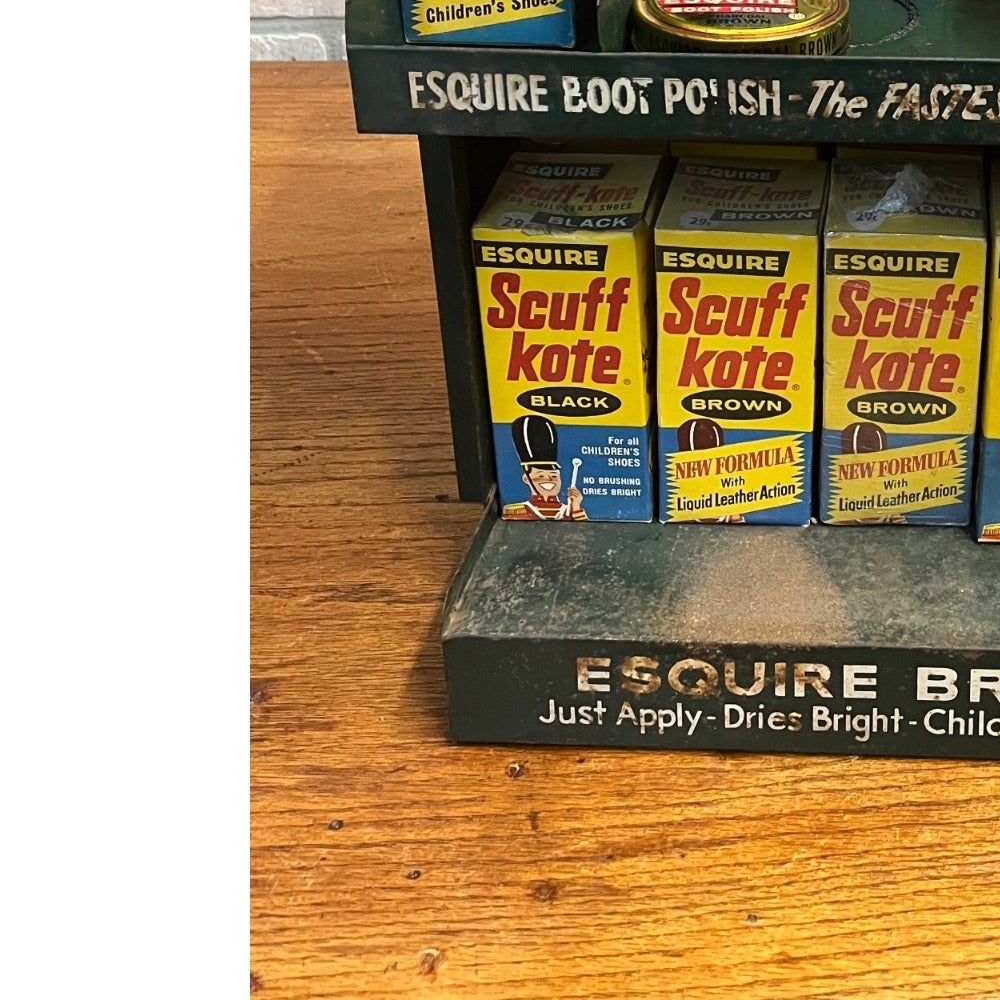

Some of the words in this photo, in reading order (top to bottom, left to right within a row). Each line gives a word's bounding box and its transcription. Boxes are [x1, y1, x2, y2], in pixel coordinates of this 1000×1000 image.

[426, 0, 505, 24] Children's
[801, 31, 838, 55] BROWN
[408, 70, 549, 113] ESQUIRE
[562, 75, 653, 115] BOOT
[807, 79, 868, 119] The
[514, 163, 600, 178] ESQUIRE
[685, 164, 772, 181] ESQUIRE
[693, 180, 813, 201] Scuff-kote
[547, 215, 629, 229] BLACK
[720, 210, 814, 221] BROWN
[481, 246, 600, 266] ESQUIRE
[662, 251, 780, 271] ESQUIRE
[834, 254, 950, 273] ESQUIRE
[486, 272, 631, 332] Scuff
[663, 277, 811, 338] Scuff
[831, 279, 979, 340] Scuff
[507, 331, 622, 384] kote
[677, 337, 795, 390] kote
[844, 339, 962, 392] kote
[530, 395, 610, 409] BLACK
[691, 398, 782, 412] BROWN
[857, 401, 948, 415] BROWN
[581, 446, 640, 456] CHILDREN'S
[608, 436, 623, 445] For
[627, 437, 639, 446] all
[607, 458, 641, 467] SHOES
[675, 459, 714, 480] NEW
[713, 446, 795, 475] FORMULA
[838, 461, 879, 482] NEW
[878, 449, 959, 476] FORMULA
[583, 476, 595, 485] NO
[598, 477, 641, 486] BRUSHING
[720, 476, 746, 488] With
[883, 478, 908, 490] With
[583, 487, 608, 496] DRIES
[610, 488, 642, 497] BRIGHT
[677, 495, 713, 512] Liquid
[715, 488, 759, 507] Leather
[759, 482, 796, 501] Action
[838, 496, 875, 512] Liquid
[877, 490, 921, 508] Leather
[921, 484, 958, 501] Action
[576, 655, 878, 700] ESQUIRE
[538, 699, 606, 725] Just
[616, 701, 702, 736] Apply
[724, 703, 802, 733] Dries
[811, 706, 904, 742] Bright
